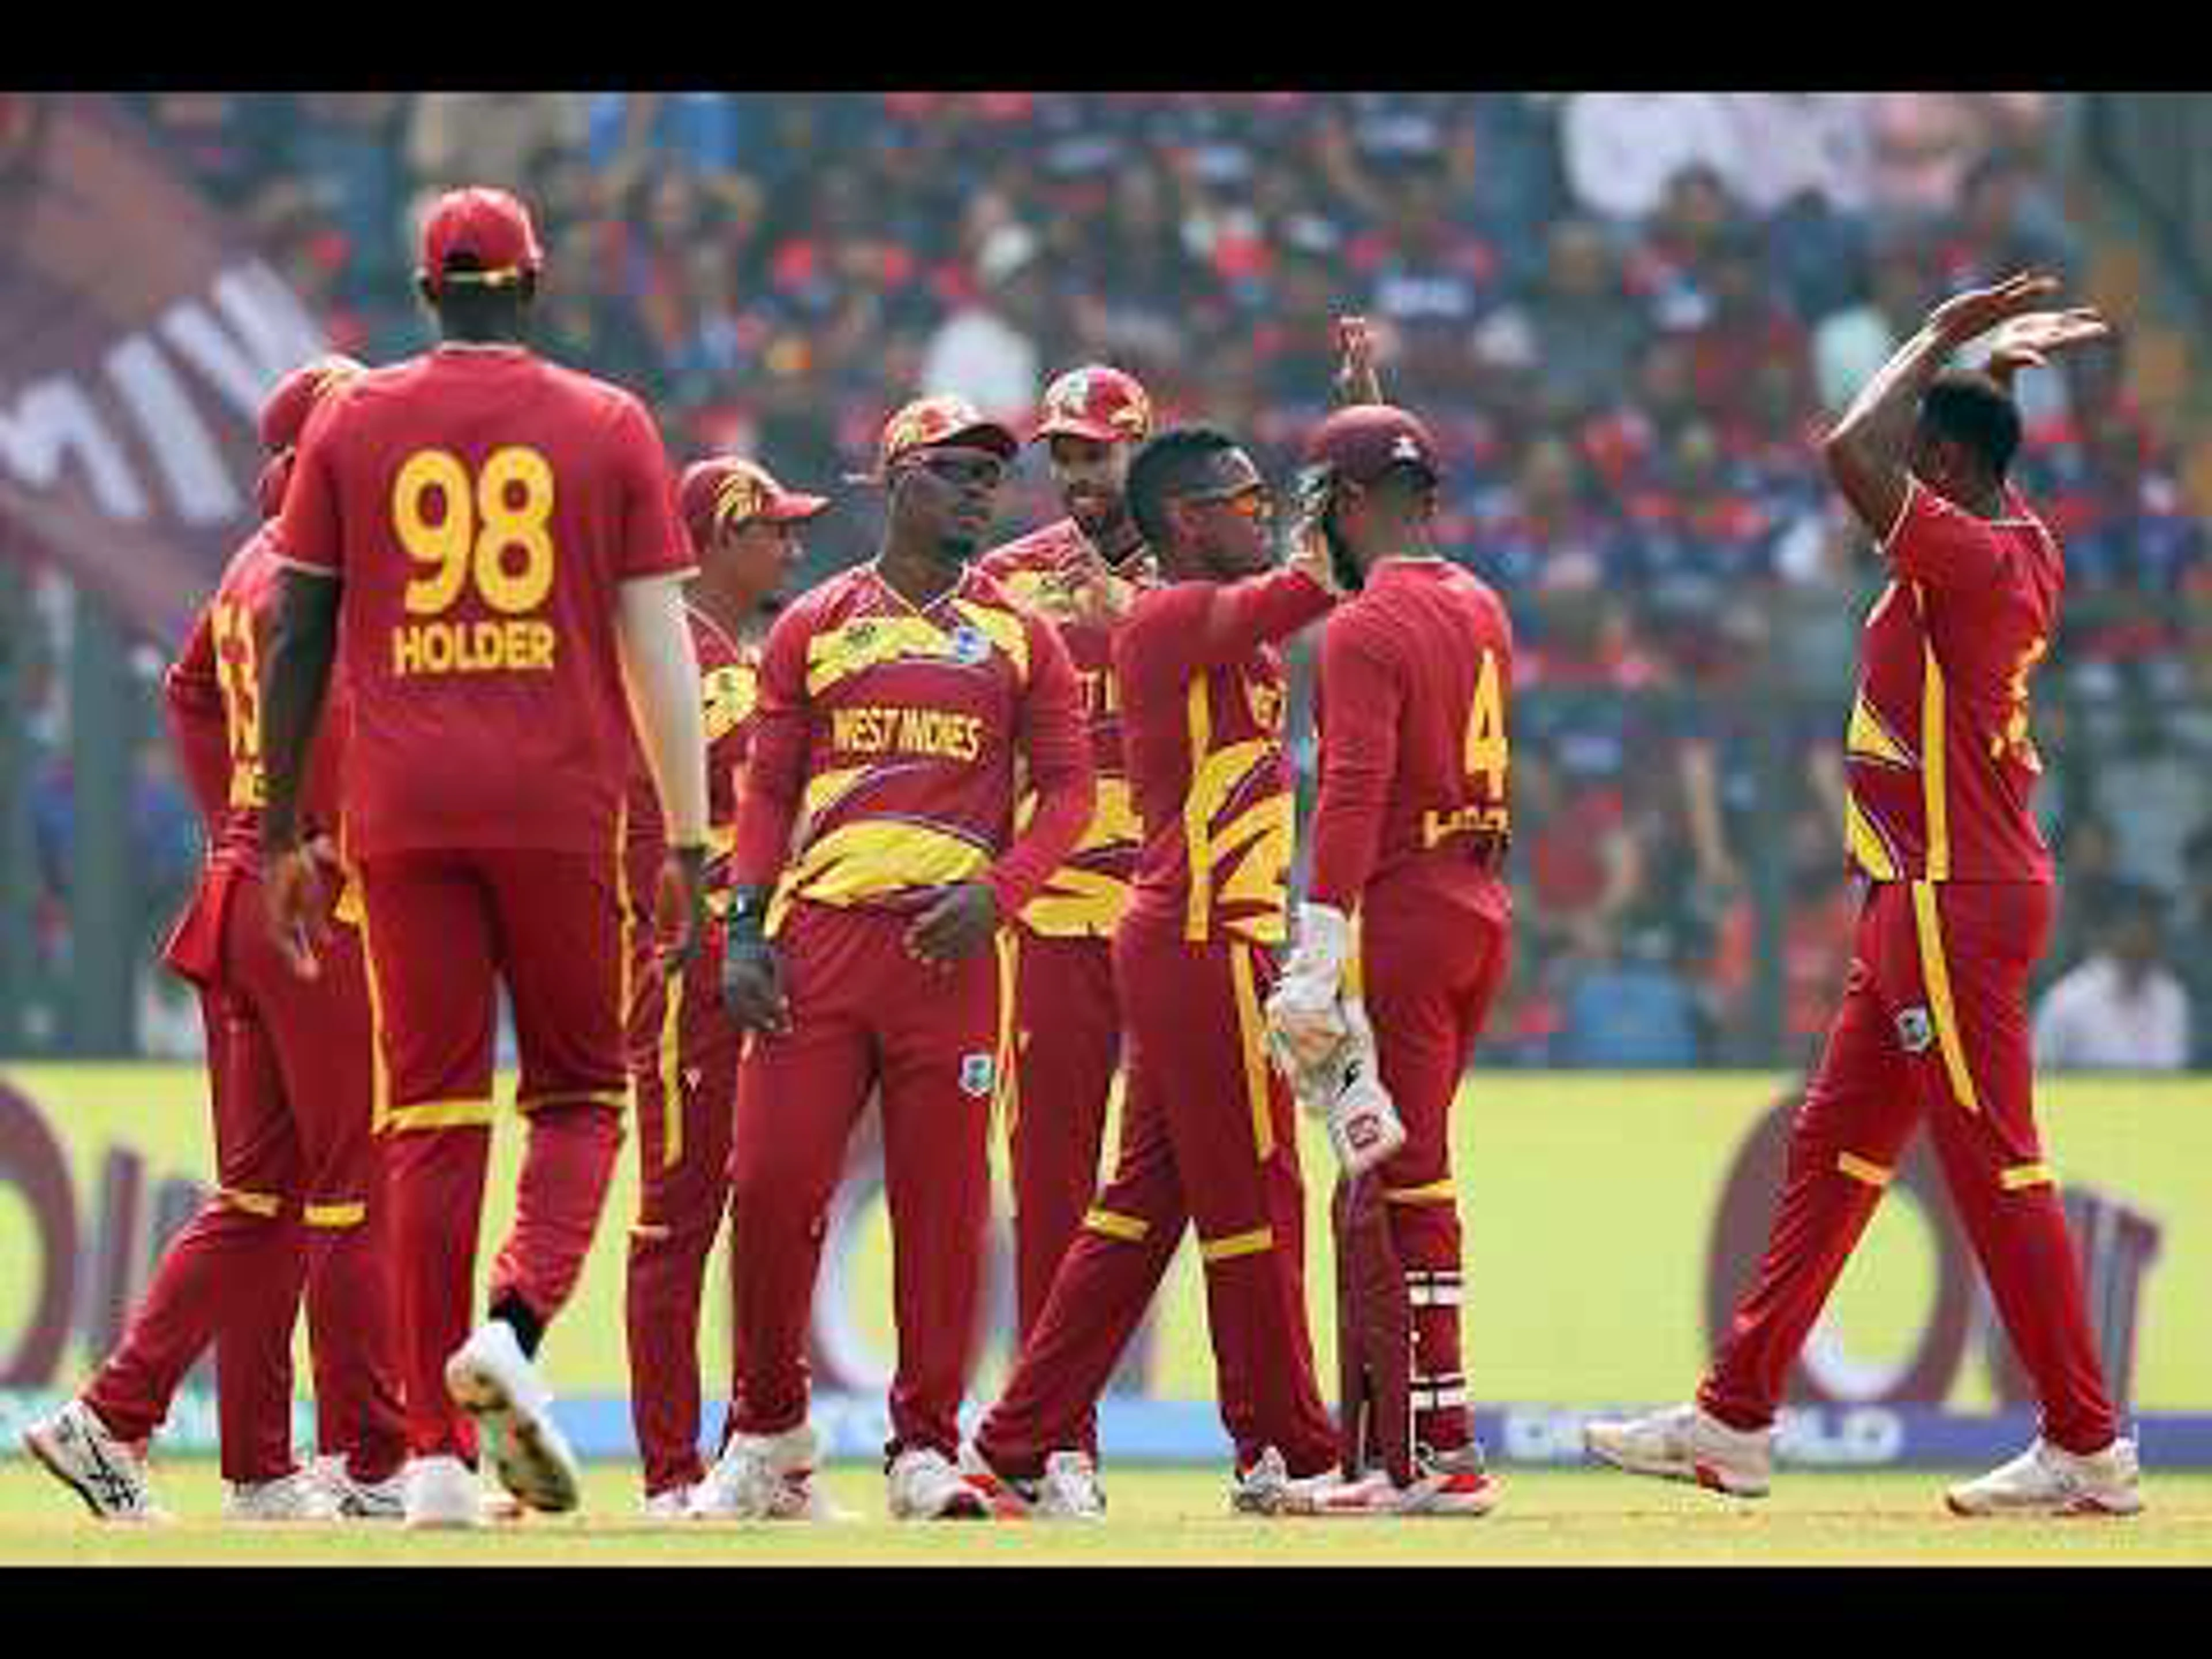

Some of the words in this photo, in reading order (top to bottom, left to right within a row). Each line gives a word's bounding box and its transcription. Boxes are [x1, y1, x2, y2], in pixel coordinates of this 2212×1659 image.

[393, 446, 554, 615] 98
[393, 622, 554, 677] HOLDER
[833, 707, 899, 752] WEST
